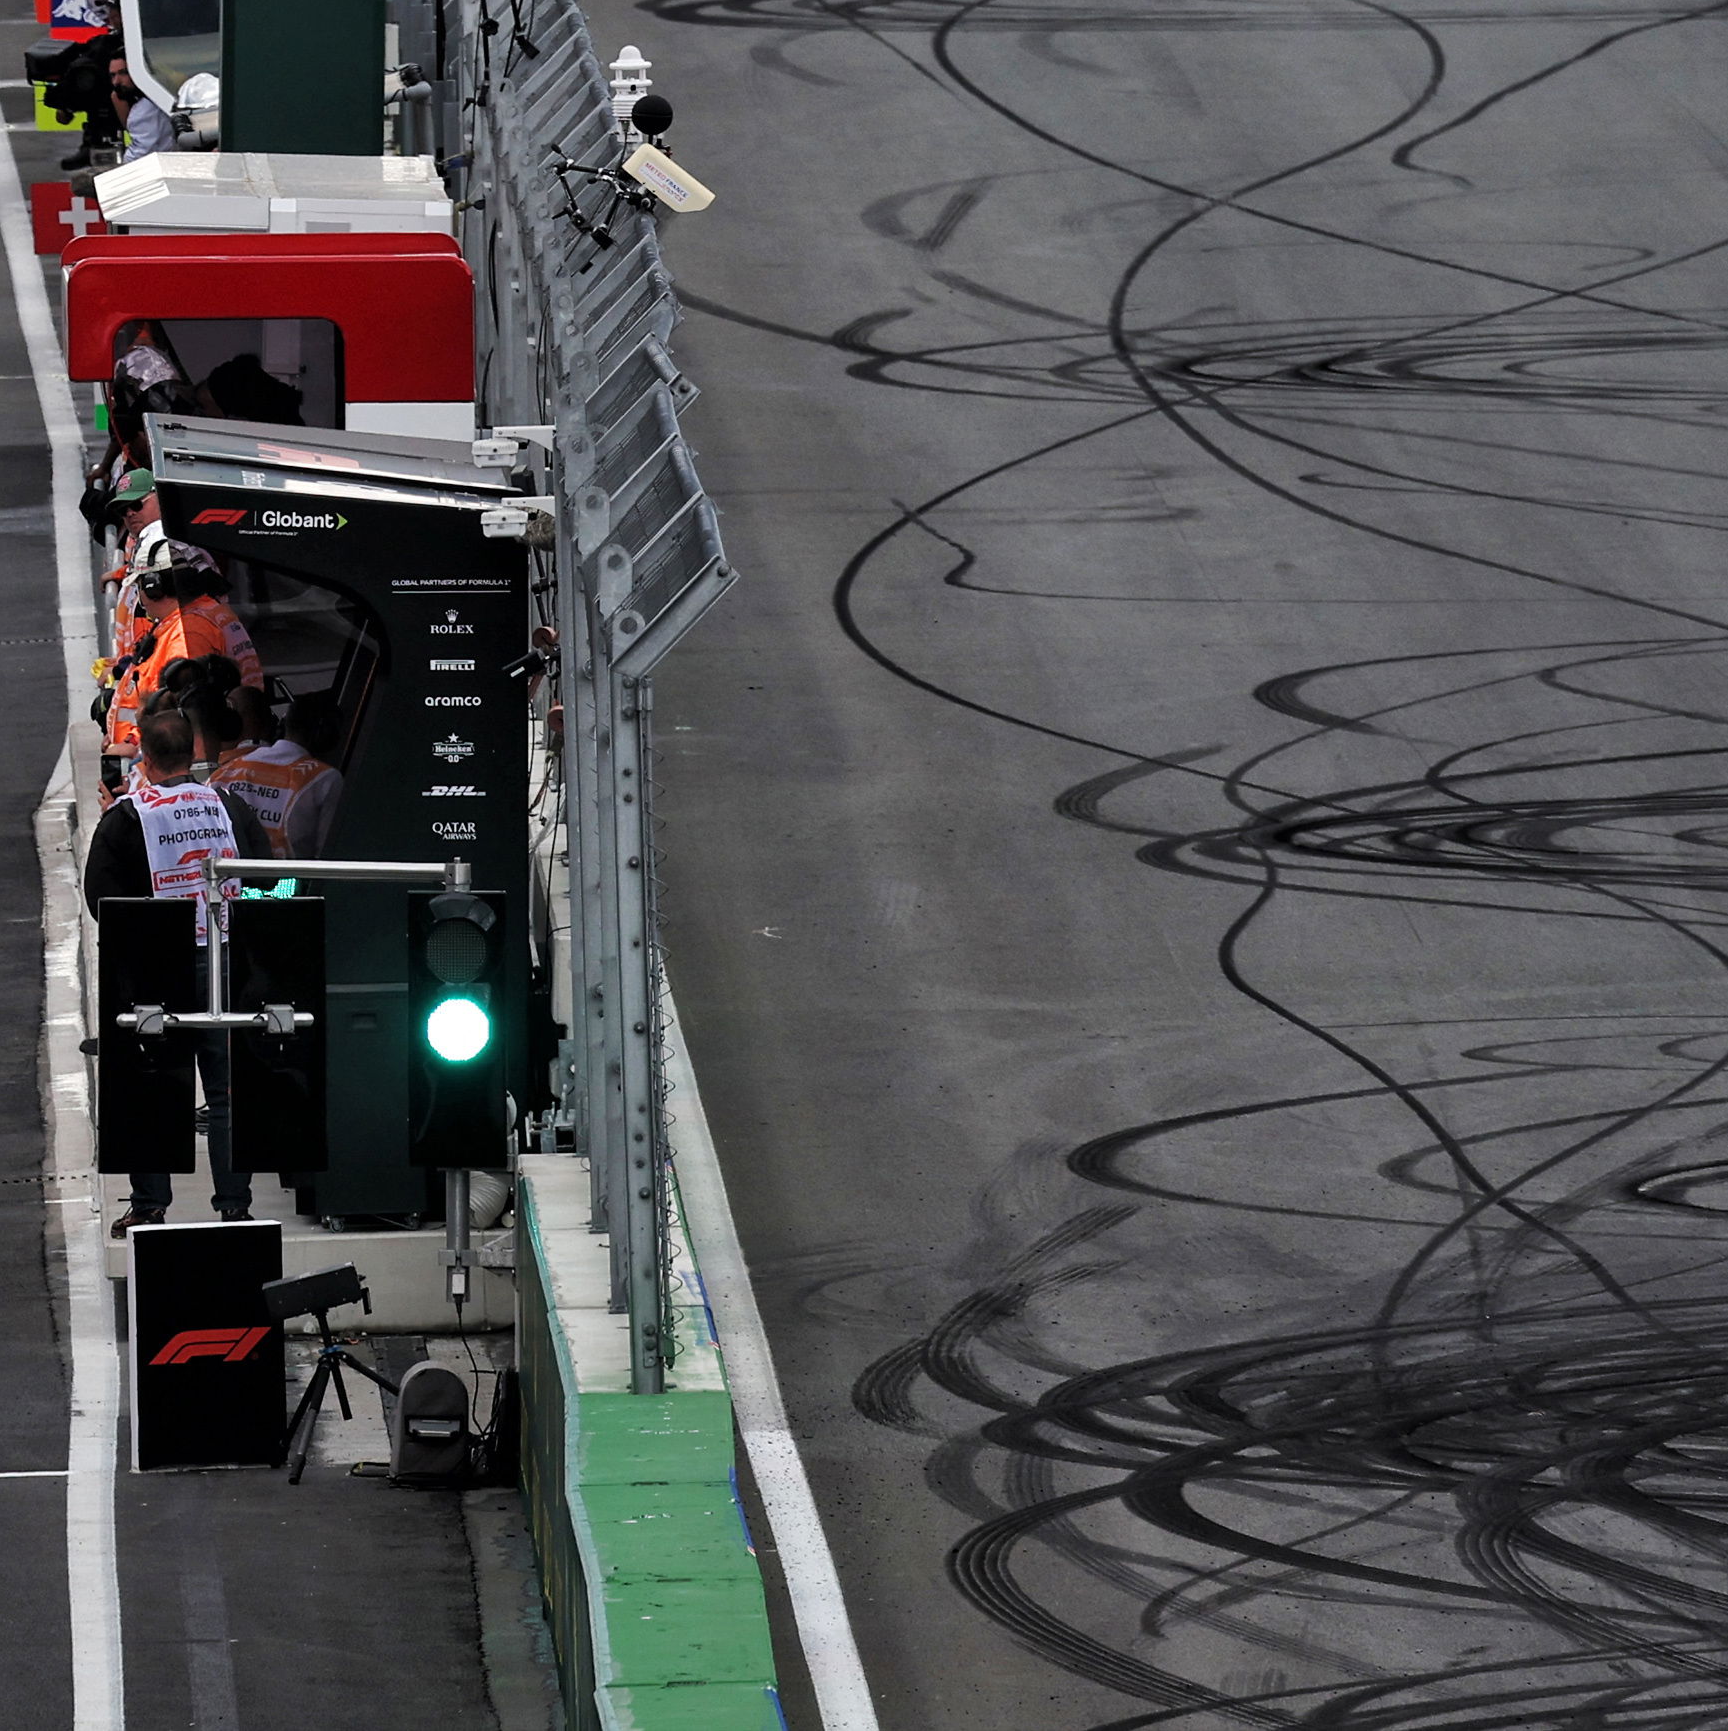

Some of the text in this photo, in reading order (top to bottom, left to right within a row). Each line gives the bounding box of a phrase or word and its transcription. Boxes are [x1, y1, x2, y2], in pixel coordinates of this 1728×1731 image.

[262, 510, 335, 529] Globant
[430, 625, 474, 634] ROLEX
[430, 659, 475, 670] PIRELLI
[425, 696, 482, 707] aramco
[434, 745, 473, 753] Heineken
[431, 786, 477, 796] DHL
[432, 822, 476, 834] QATAR
